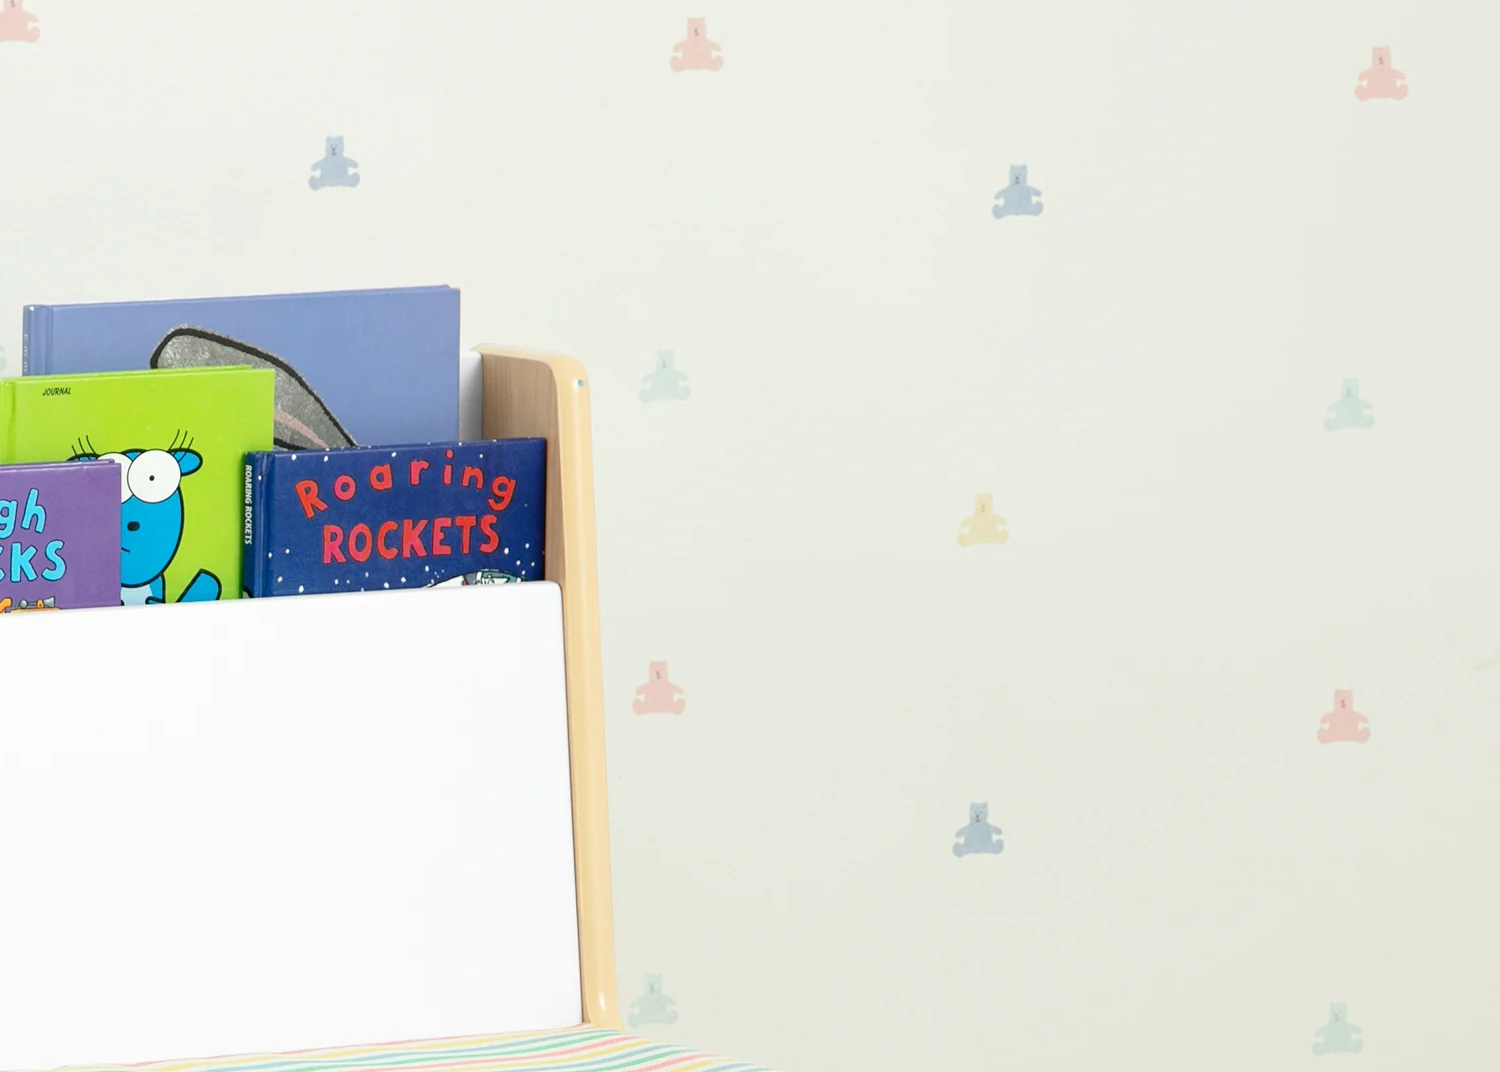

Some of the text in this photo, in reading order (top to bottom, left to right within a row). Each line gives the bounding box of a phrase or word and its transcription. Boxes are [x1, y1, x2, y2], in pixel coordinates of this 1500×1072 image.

[42, 385, 72, 397] JOURNAL
[245, 464, 253, 545] ROARING ROCKETS
[294, 450, 517, 521] Roaring
[322, 513, 501, 565] ROCKETS
